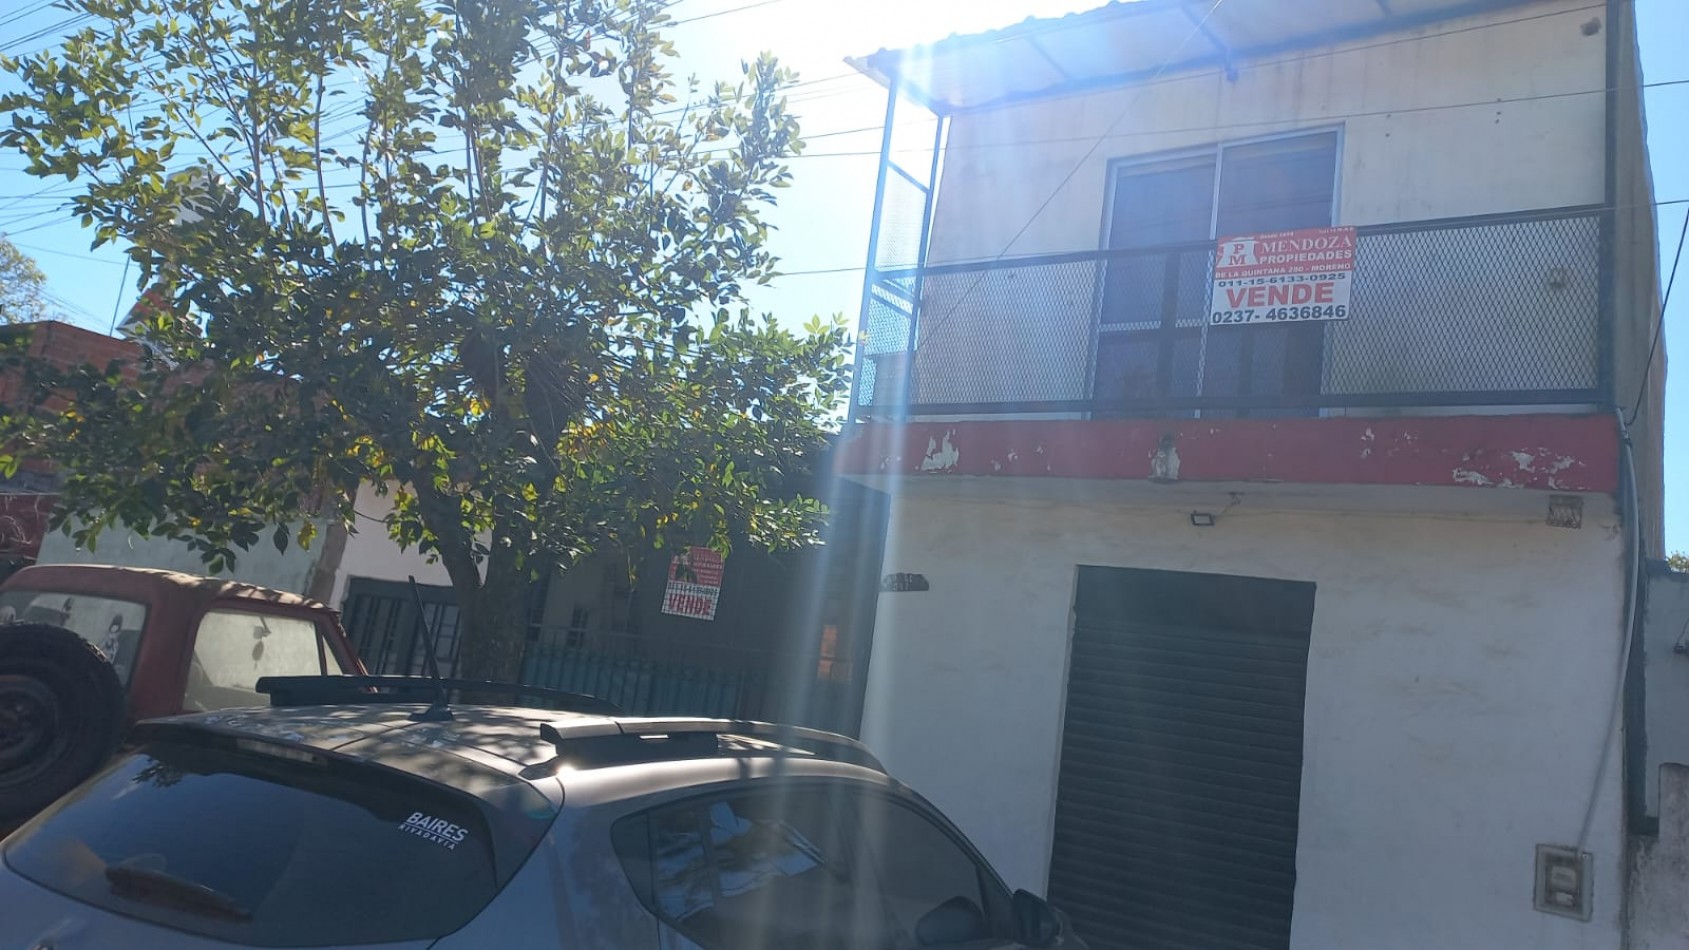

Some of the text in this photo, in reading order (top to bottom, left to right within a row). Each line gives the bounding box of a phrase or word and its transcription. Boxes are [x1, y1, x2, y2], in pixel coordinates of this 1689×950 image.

[1260, 236, 1352, 254] MENDOZA
[1260, 250, 1352, 264] PROPIEDADES
[1242, 267, 1285, 276] QUINTANA
[1312, 263, 1350, 271] MORENO
[1218, 273, 1346, 288] 011-15-6133-0925
[1226, 282, 1334, 308] VENDE
[1266, 305, 1346, 320] 4636846
[668, 593, 712, 615] VENDE
[406, 812, 469, 841] BAIRES
[398, 824, 456, 850] RIVADAVIA
